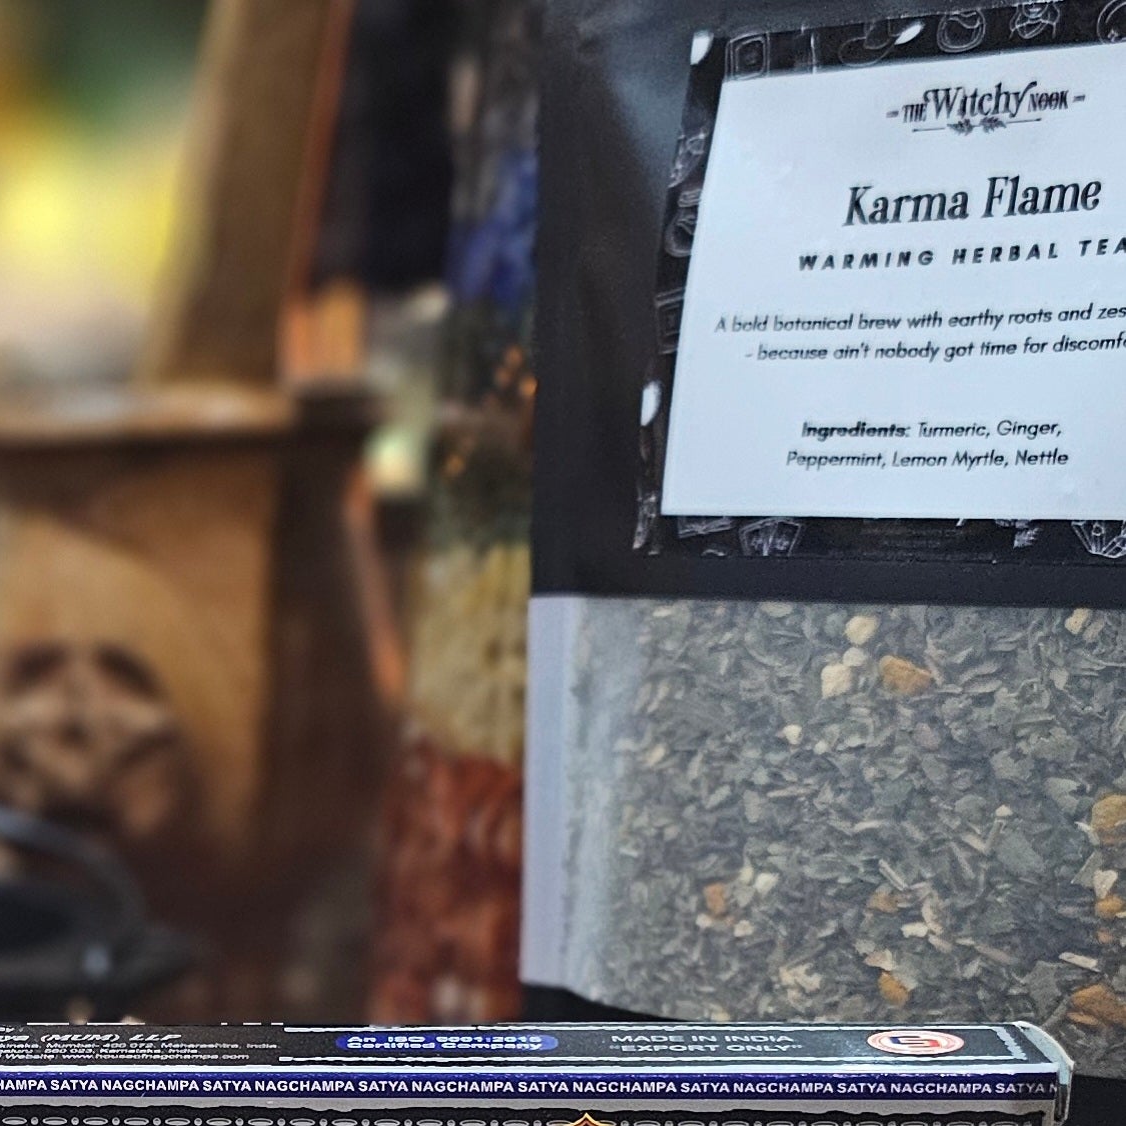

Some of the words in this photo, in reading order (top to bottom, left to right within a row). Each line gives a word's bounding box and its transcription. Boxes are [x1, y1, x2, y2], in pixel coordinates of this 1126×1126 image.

[903, 103, 925, 123] THE
[923, 81, 1037, 120] Witchy
[1028, 90, 1069, 112] NOOK
[842, 185, 969, 226] Karma
[981, 174, 1102, 218] Flame
[799, 250, 933, 271] WARMING
[952, 243, 1058, 265] HERBAL
[1079, 237, 1126, 257] TEA
[714, 316, 727, 332] A
[731, 315, 769, 332] bold
[773, 313, 854, 332] botanical
[858, 314, 901, 330] brew
[907, 311, 942, 328] with
[948, 308, 1004, 331] earthy
[1008, 309, 1052, 325] roots
[1057, 302, 1094, 322] and
[757, 344, 828, 360] because
[833, 342, 870, 360] ain't
[874, 341, 939, 363] nobody
[944, 342, 974, 362] got
[980, 341, 1017, 356] time
[1023, 336, 1048, 354] for
[801, 421, 911, 442] Ingredients:
[918, 421, 990, 439] Turmeric,
[997, 419, 1062, 440] Ginger,
[786, 450, 886, 471] Peppermint,
[892, 450, 947, 467] Lemon
[951, 448, 1009, 472] Myrtle,
[1015, 447, 1069, 466] Nettle
[612, 1034, 684, 1043] MADE
[691, 1034, 717, 1043] IN
[724, 1034, 794, 1043] INDIA
[51, 1079, 98, 1091] SATYA
[102, 1079, 199, 1092] NAGCHAMPA
[203, 1080, 251, 1092] SATYA
[255, 1080, 354, 1092] NAGCHAMPA
[359, 1080, 408, 1092] SATYA
[412, 1080, 514, 1093] NAGCHAMPA
[518, 1081, 568, 1093] SATYA
[573, 1081, 677, 1093] NAGCHAMPA
[681, 1082, 730, 1093] SATYA
[734, 1082, 833, 1094] NAGCHAMPA
[837, 1082, 886, 1094] SATYA
[891, 1082, 991, 1094] NAGCHAMPA
[996, 1082, 1043, 1094] SATYA
